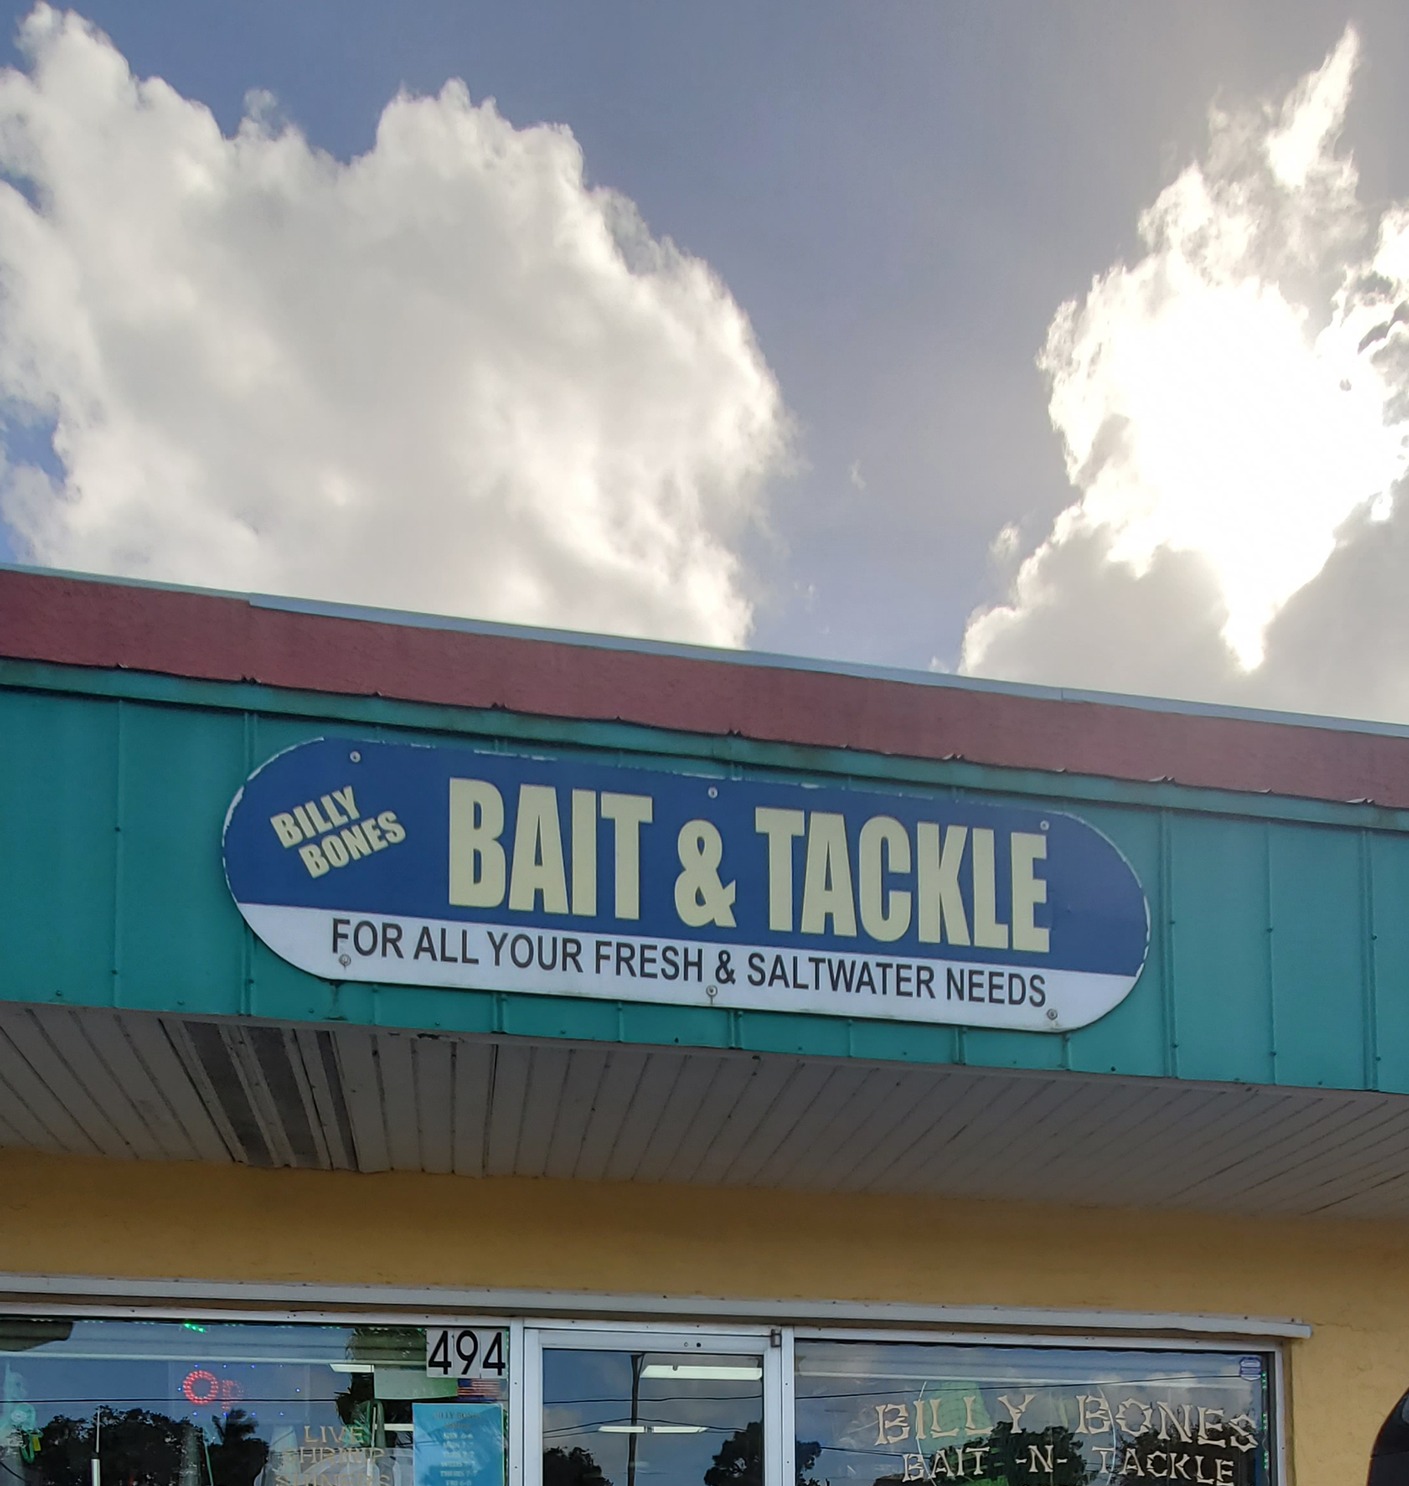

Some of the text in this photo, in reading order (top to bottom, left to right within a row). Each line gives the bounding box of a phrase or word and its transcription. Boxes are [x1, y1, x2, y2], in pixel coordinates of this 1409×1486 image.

[270, 786, 361, 849] BILLY
[298, 810, 407, 879] BONES
[449, 777, 1051, 953] BAIT & TACKLE
[331, 918, 1047, 1008] FOR ALL YOUR FRESH & SALTWATER NEEDS
[428, 1330, 506, 1376] 494
[304, 1425, 364, 1443] LIVE
[874, 1394, 1259, 1453] BILLY BONES
[902, 1446, 991, 1483] BAIT
